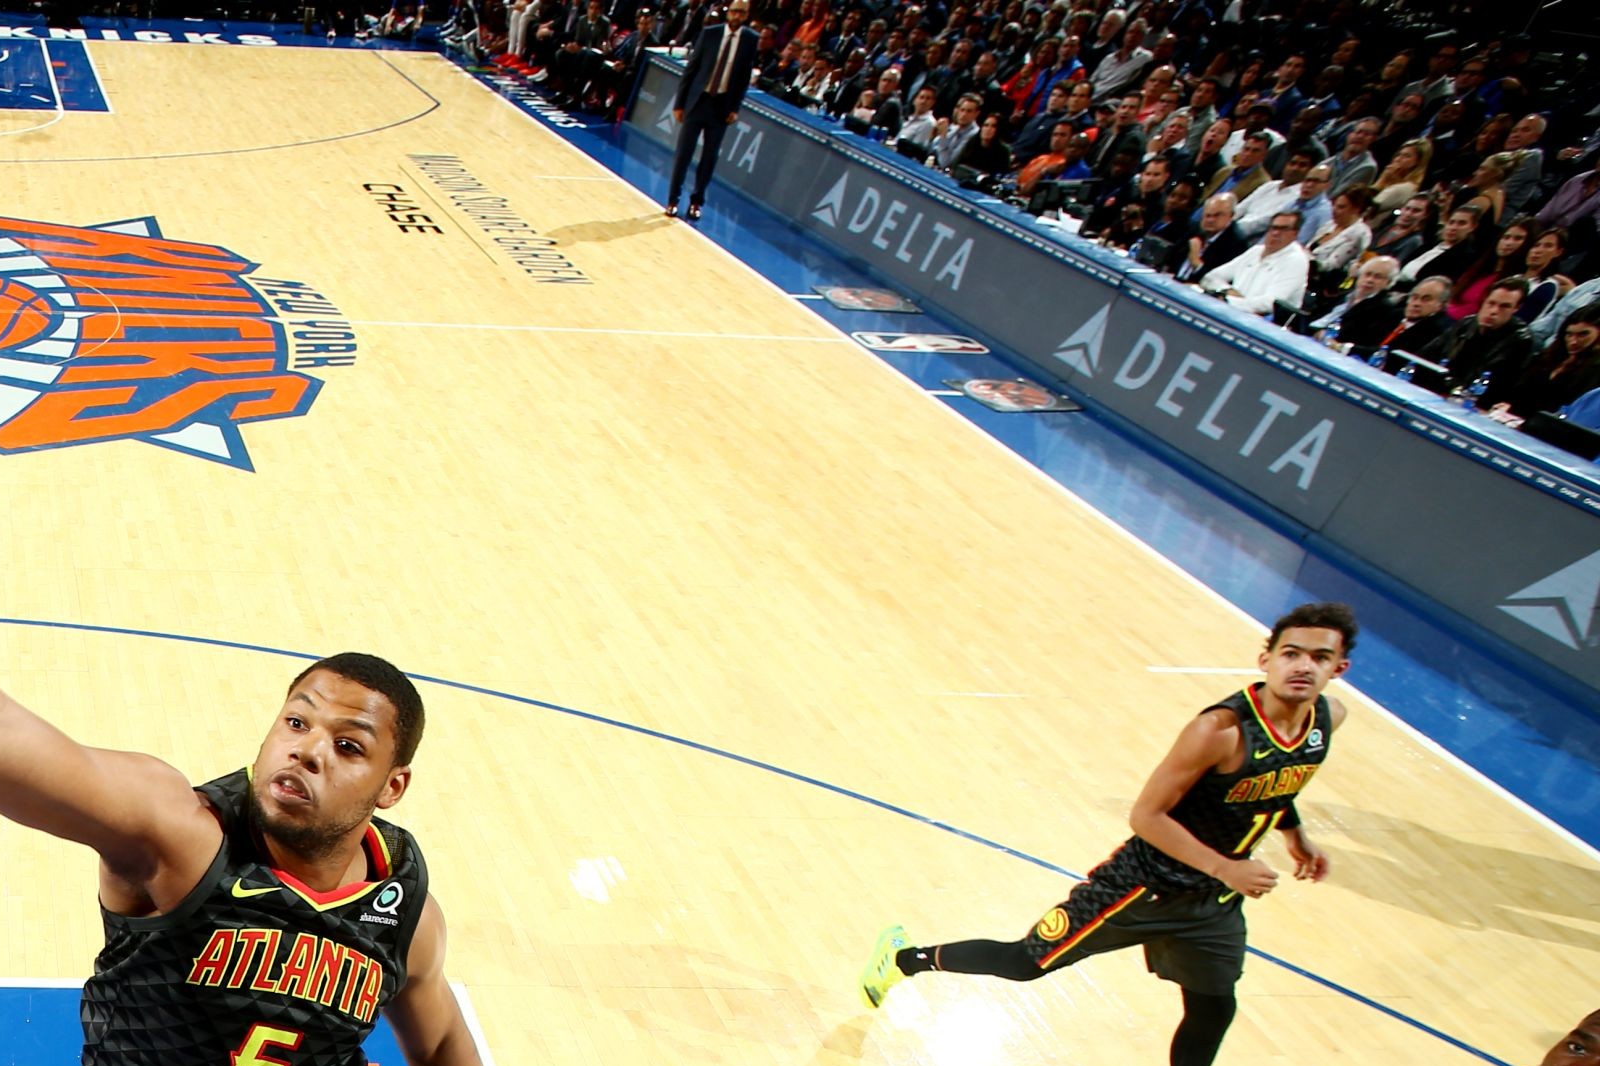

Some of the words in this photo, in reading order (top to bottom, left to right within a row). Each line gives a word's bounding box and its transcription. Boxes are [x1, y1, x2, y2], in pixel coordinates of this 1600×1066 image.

[405, 154, 491, 193] MADISON
[363, 183, 444, 235] CHASE
[450, 195, 537, 234] SQUARE
[493, 237, 594, 284] GARDEN
[847, 186, 975, 291] DELTA
[247, 276, 343, 316] NEW
[289, 321, 358, 369] YORK
[1112, 329, 1335, 490] DELTA
[1224, 763, 1321, 803] ATLANT
[359, 912, 399, 927] sharecare
[185, 929, 383, 1023] ATLANTA
